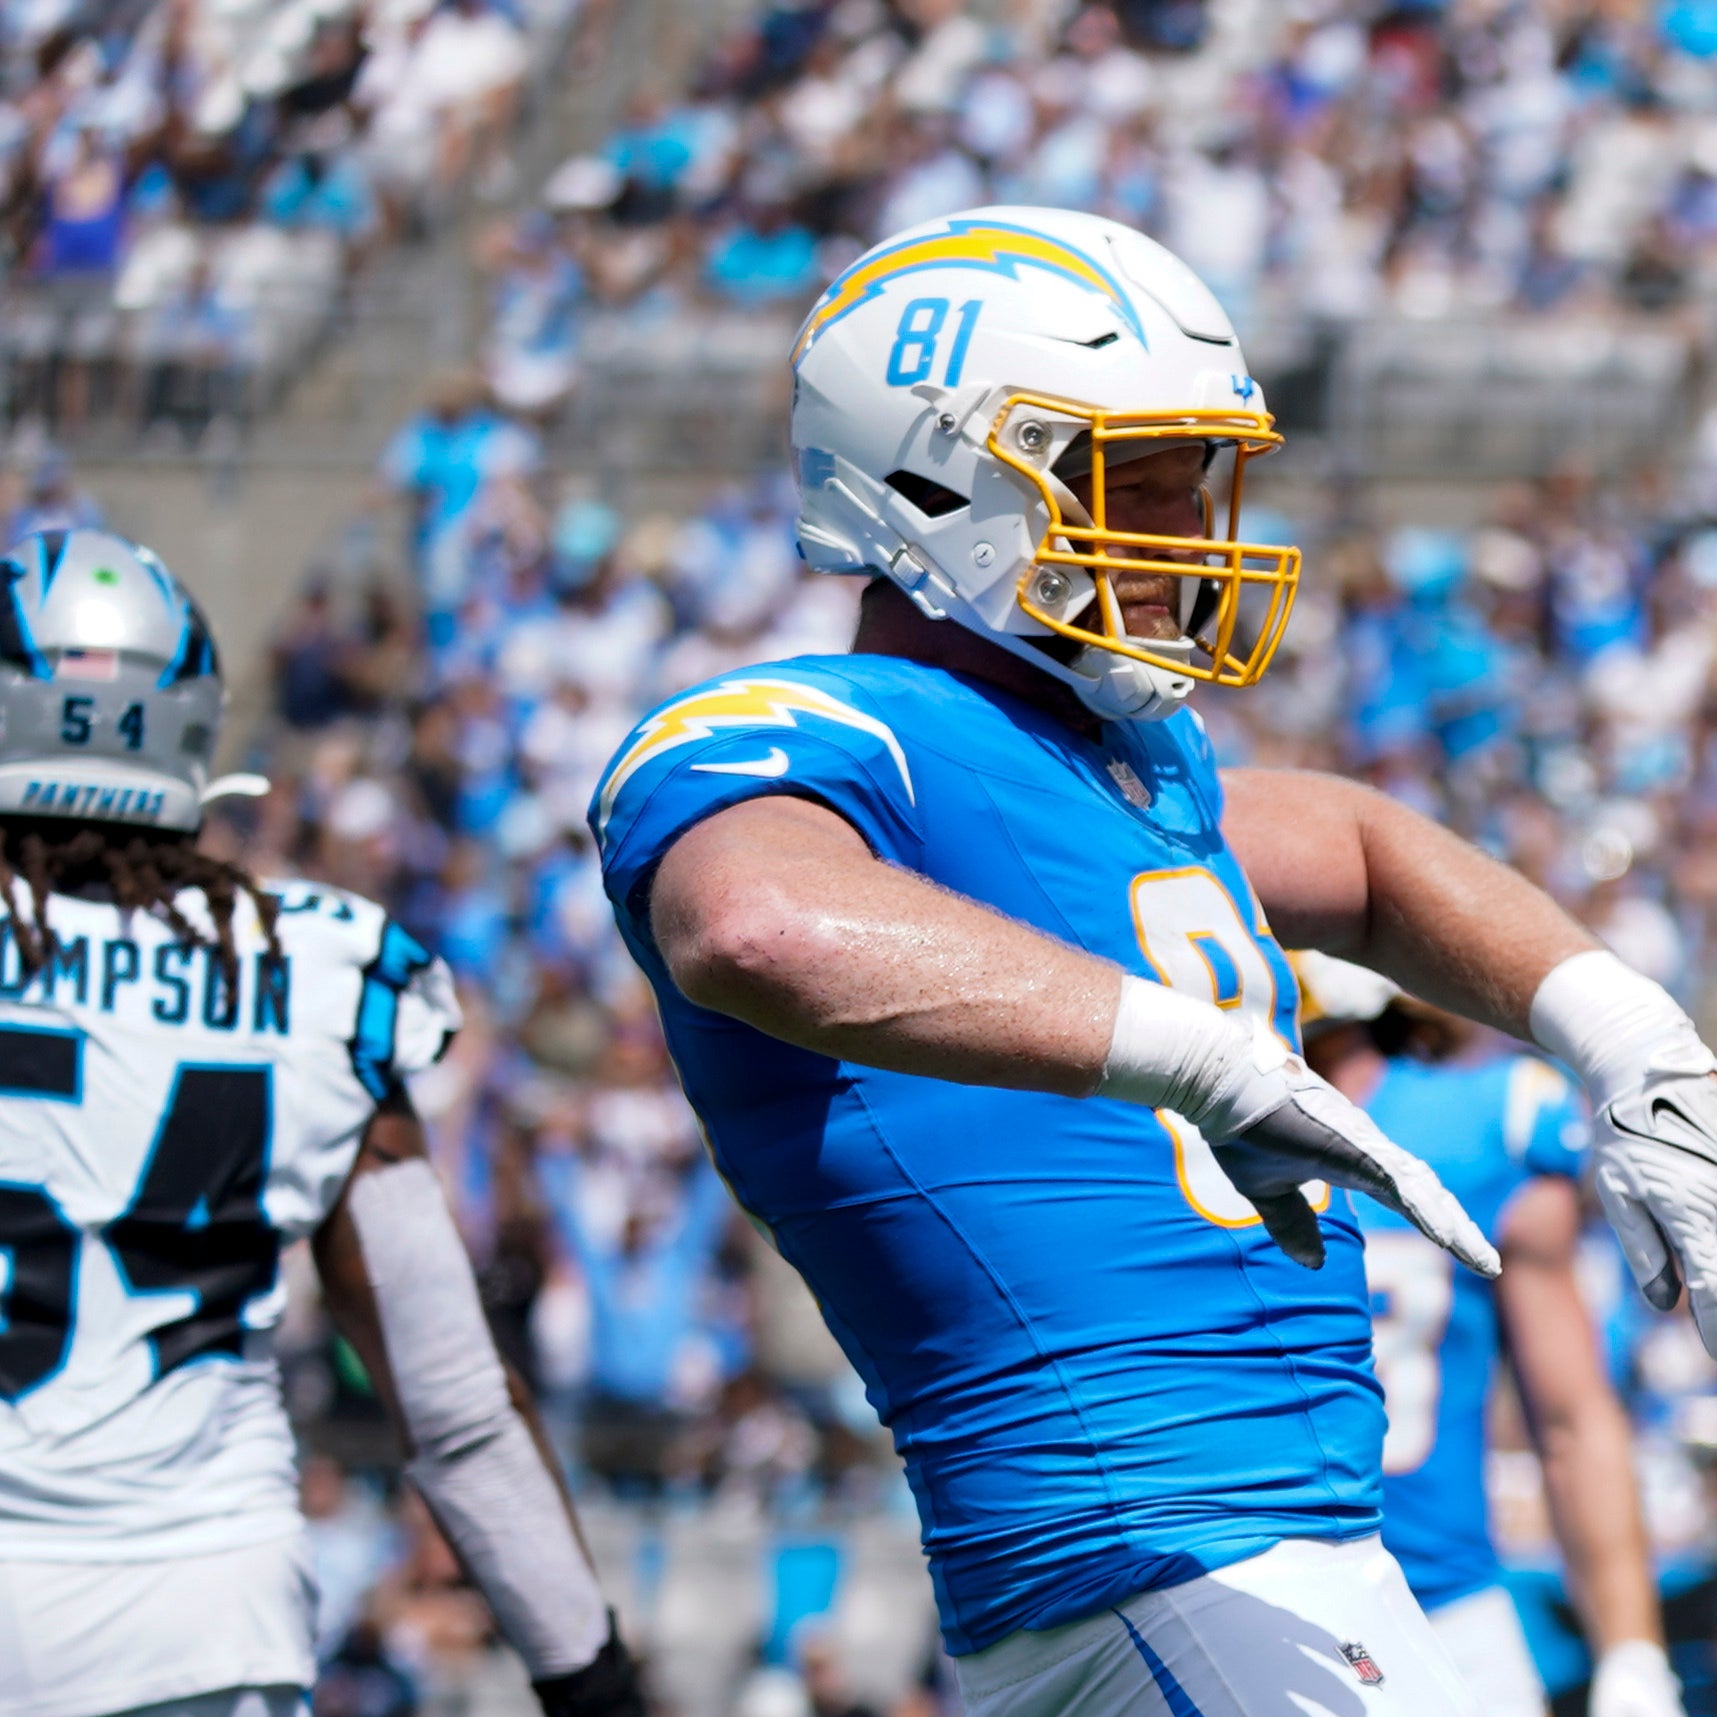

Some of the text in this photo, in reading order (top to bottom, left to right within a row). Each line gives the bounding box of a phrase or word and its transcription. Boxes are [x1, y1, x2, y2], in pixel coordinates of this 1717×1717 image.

[885, 297, 984, 388] 81
[60, 696, 144, 750] 54
[21, 781, 166, 817] PANTHERS
